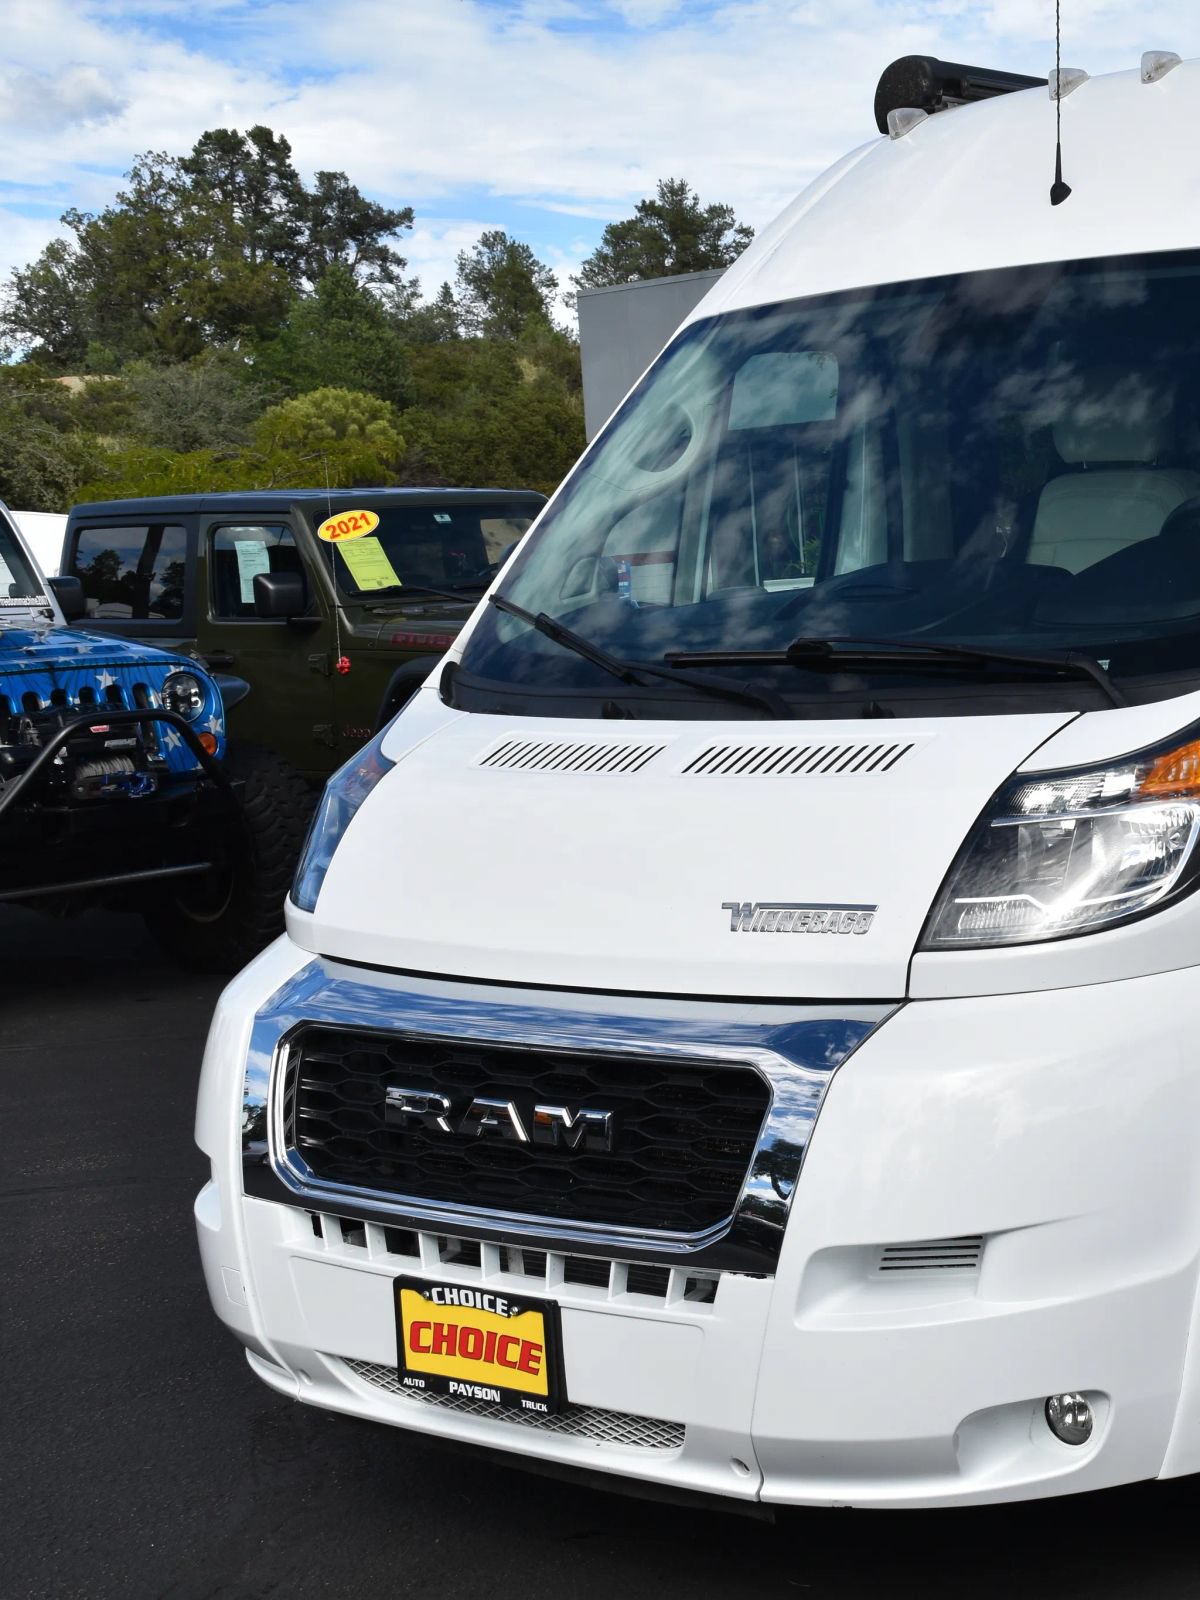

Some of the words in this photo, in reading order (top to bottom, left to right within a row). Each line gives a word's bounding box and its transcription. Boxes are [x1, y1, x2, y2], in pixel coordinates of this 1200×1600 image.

[325, 513, 372, 540] 2021
[384, 1086, 615, 1151] RAM
[431, 1287, 509, 1317] CHOICE
[409, 1320, 543, 1376] CHOICE
[403, 1377, 426, 1388] AUTO
[449, 1381, 501, 1402] PAYSON
[520, 1399, 549, 1413] TRUCK
